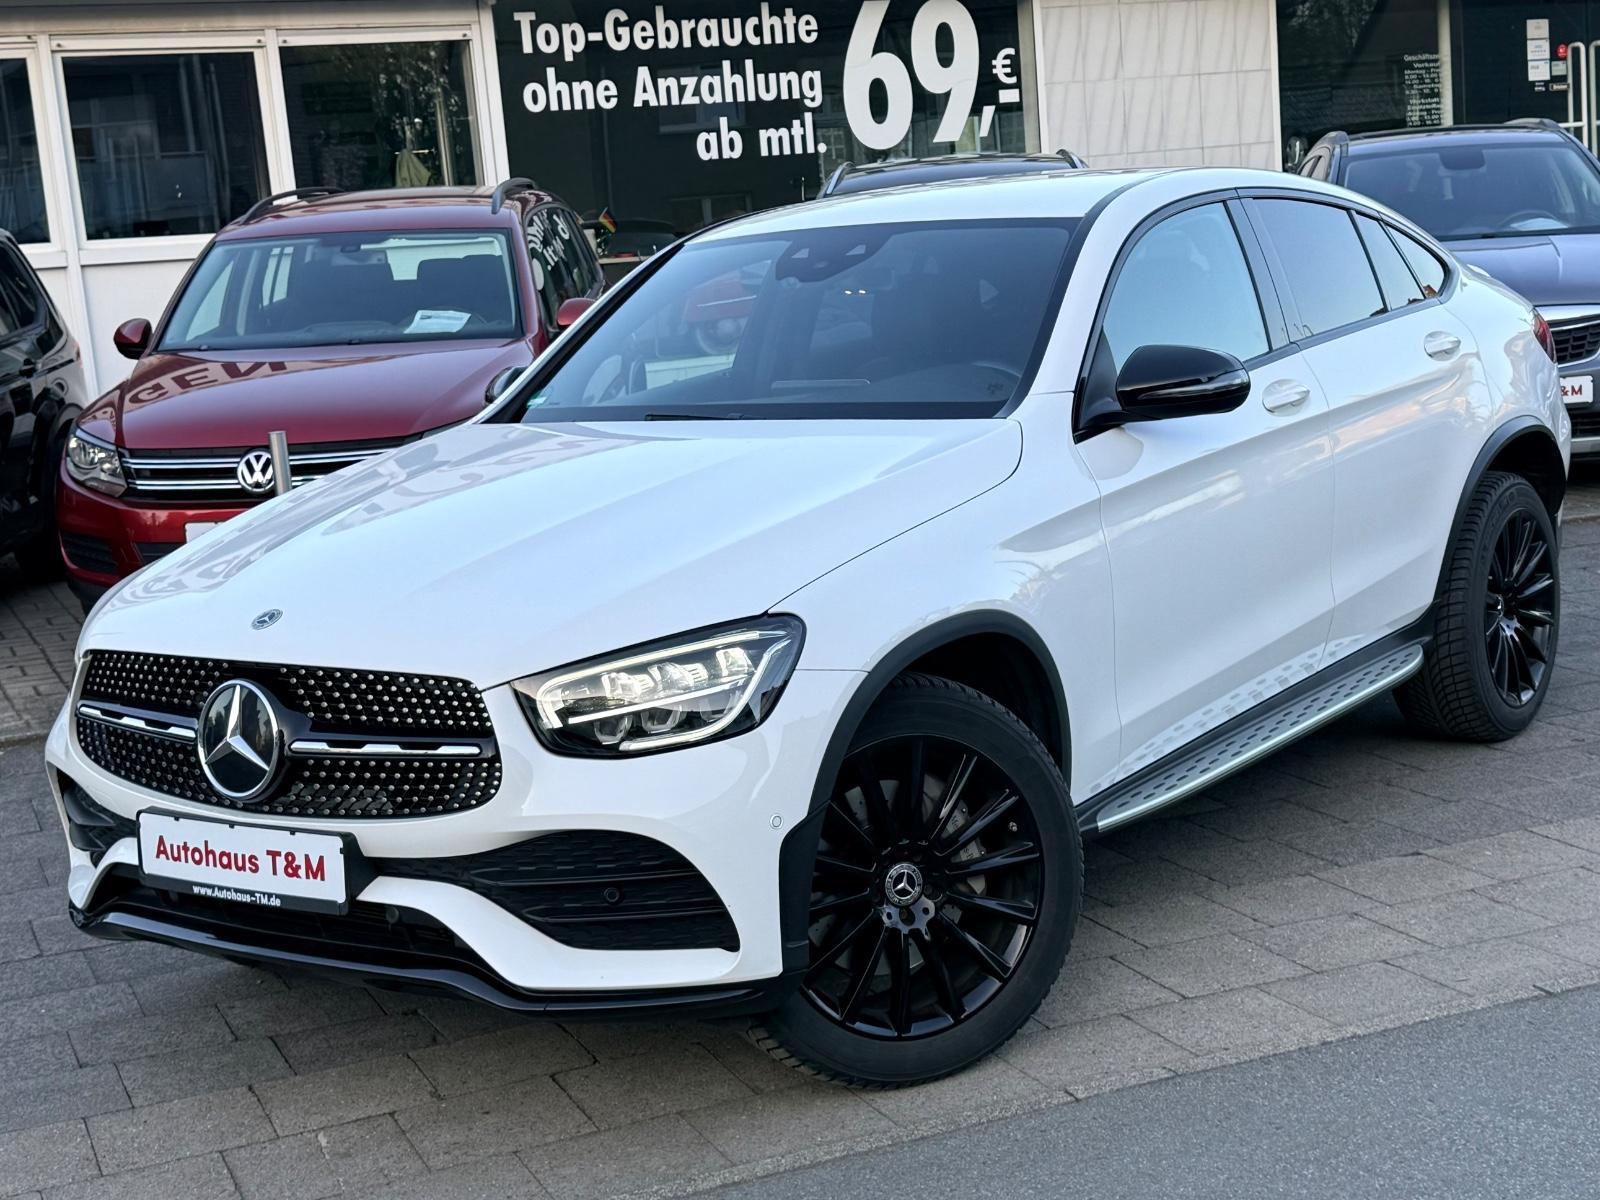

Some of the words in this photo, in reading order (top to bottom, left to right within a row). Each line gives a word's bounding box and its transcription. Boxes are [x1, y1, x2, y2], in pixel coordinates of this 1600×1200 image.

[513, 2, 819, 62] Top-Gebrauchte
[522, 66, 618, 113] ohne
[633, 59, 823, 107] Anzahlung
[991, 48, 1017, 85] €
[696, 116, 743, 162] ab
[759, 112, 828, 156] mtl.
[155, 834, 260, 874] Autohaus
[266, 850, 326, 881] T&M
[193, 885, 281, 907] www.Autohaus-TM.de
